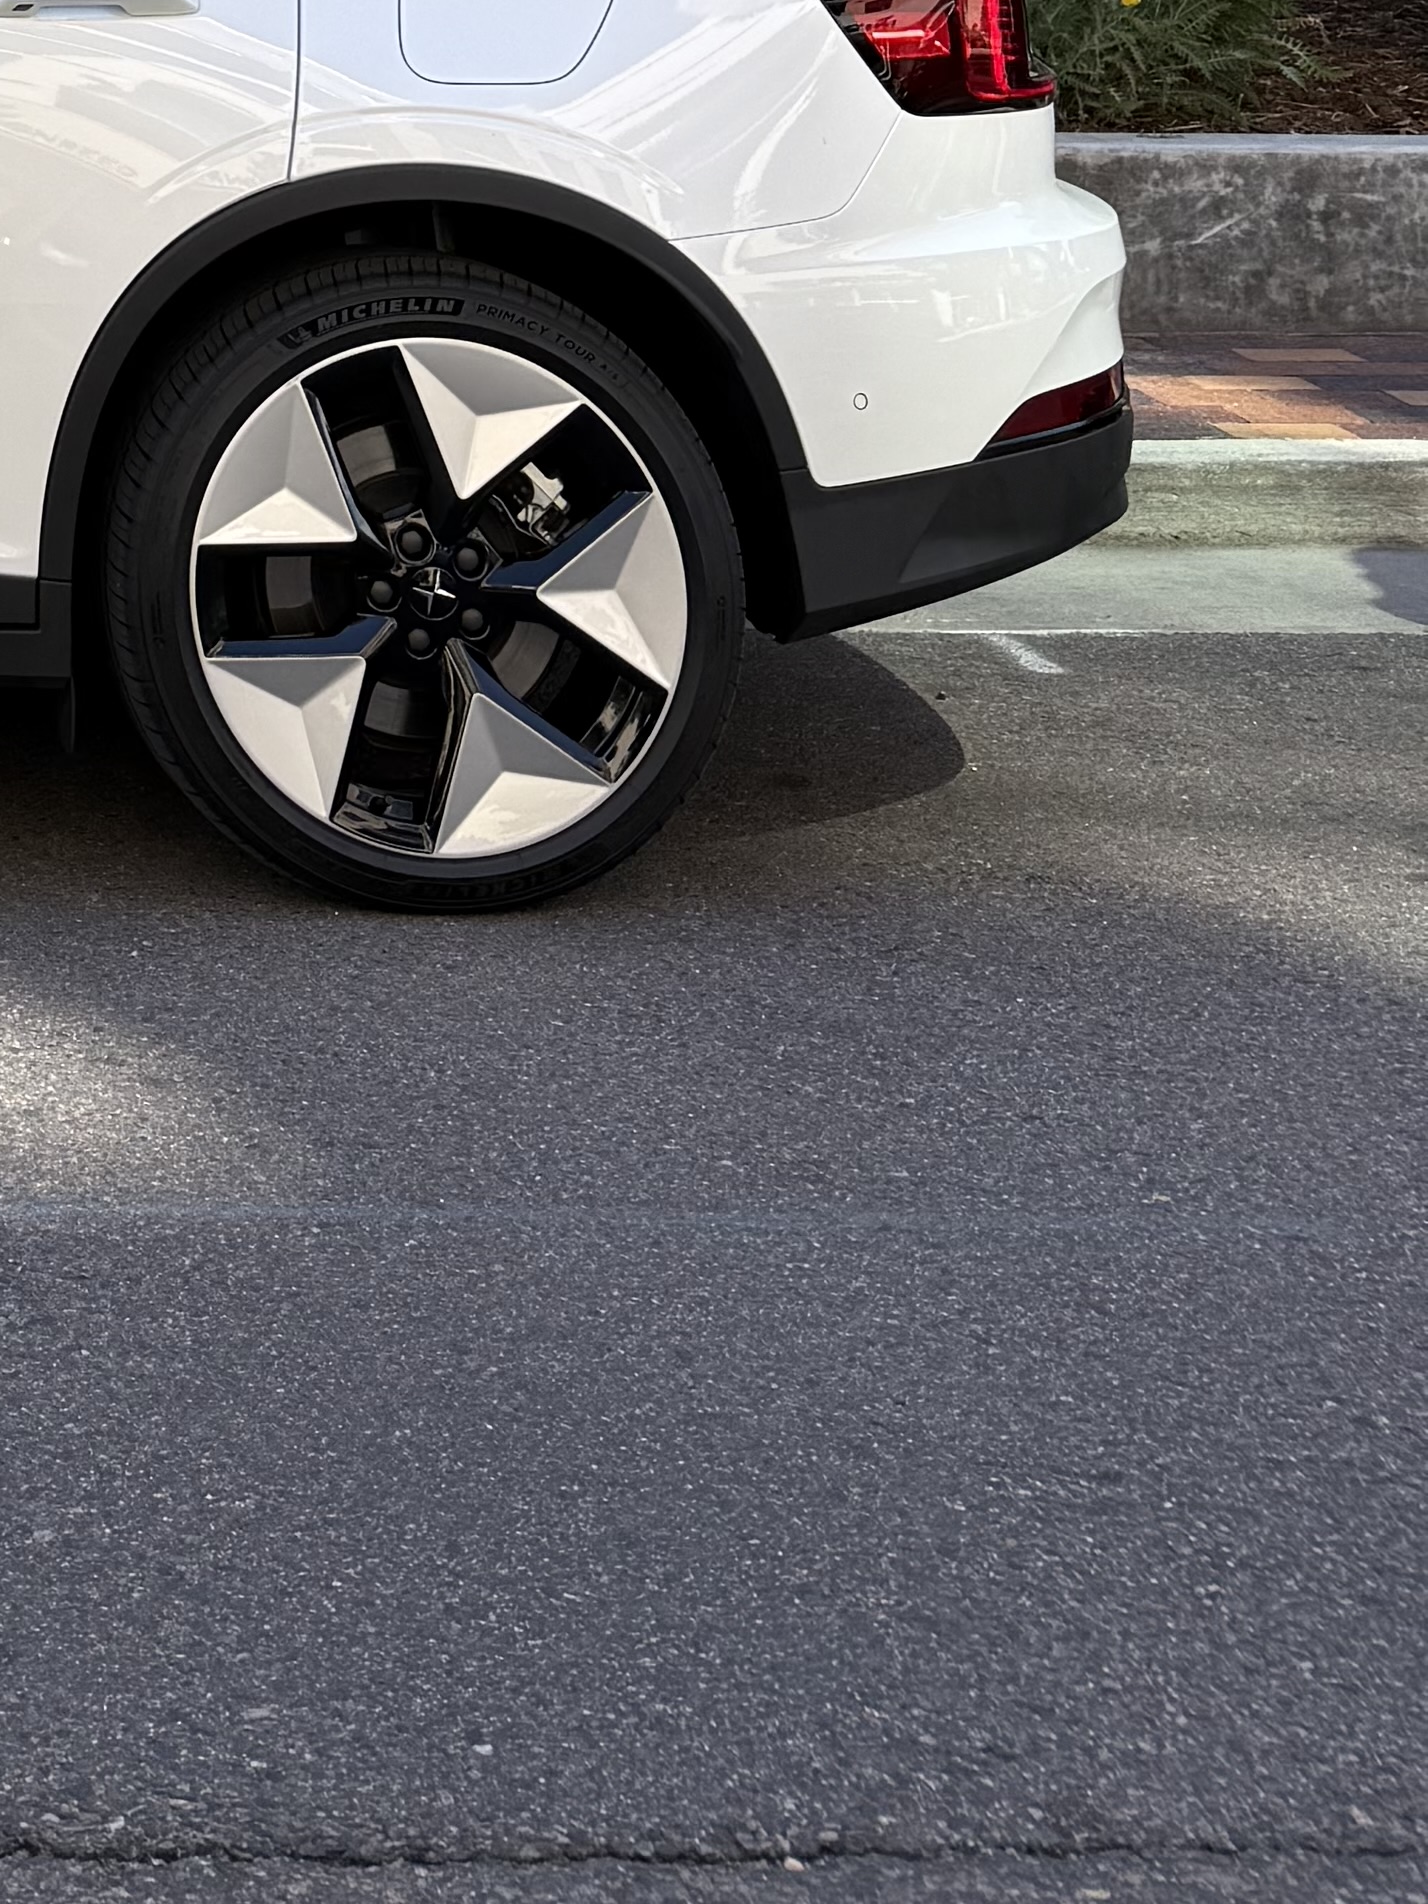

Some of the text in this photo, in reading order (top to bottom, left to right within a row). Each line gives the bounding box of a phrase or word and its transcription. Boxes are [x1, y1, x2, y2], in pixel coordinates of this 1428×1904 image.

[317, 297, 455, 331] MICHELIN
[476, 303, 550, 336] PRIMACY
[555, 333, 596, 365] TOUR
